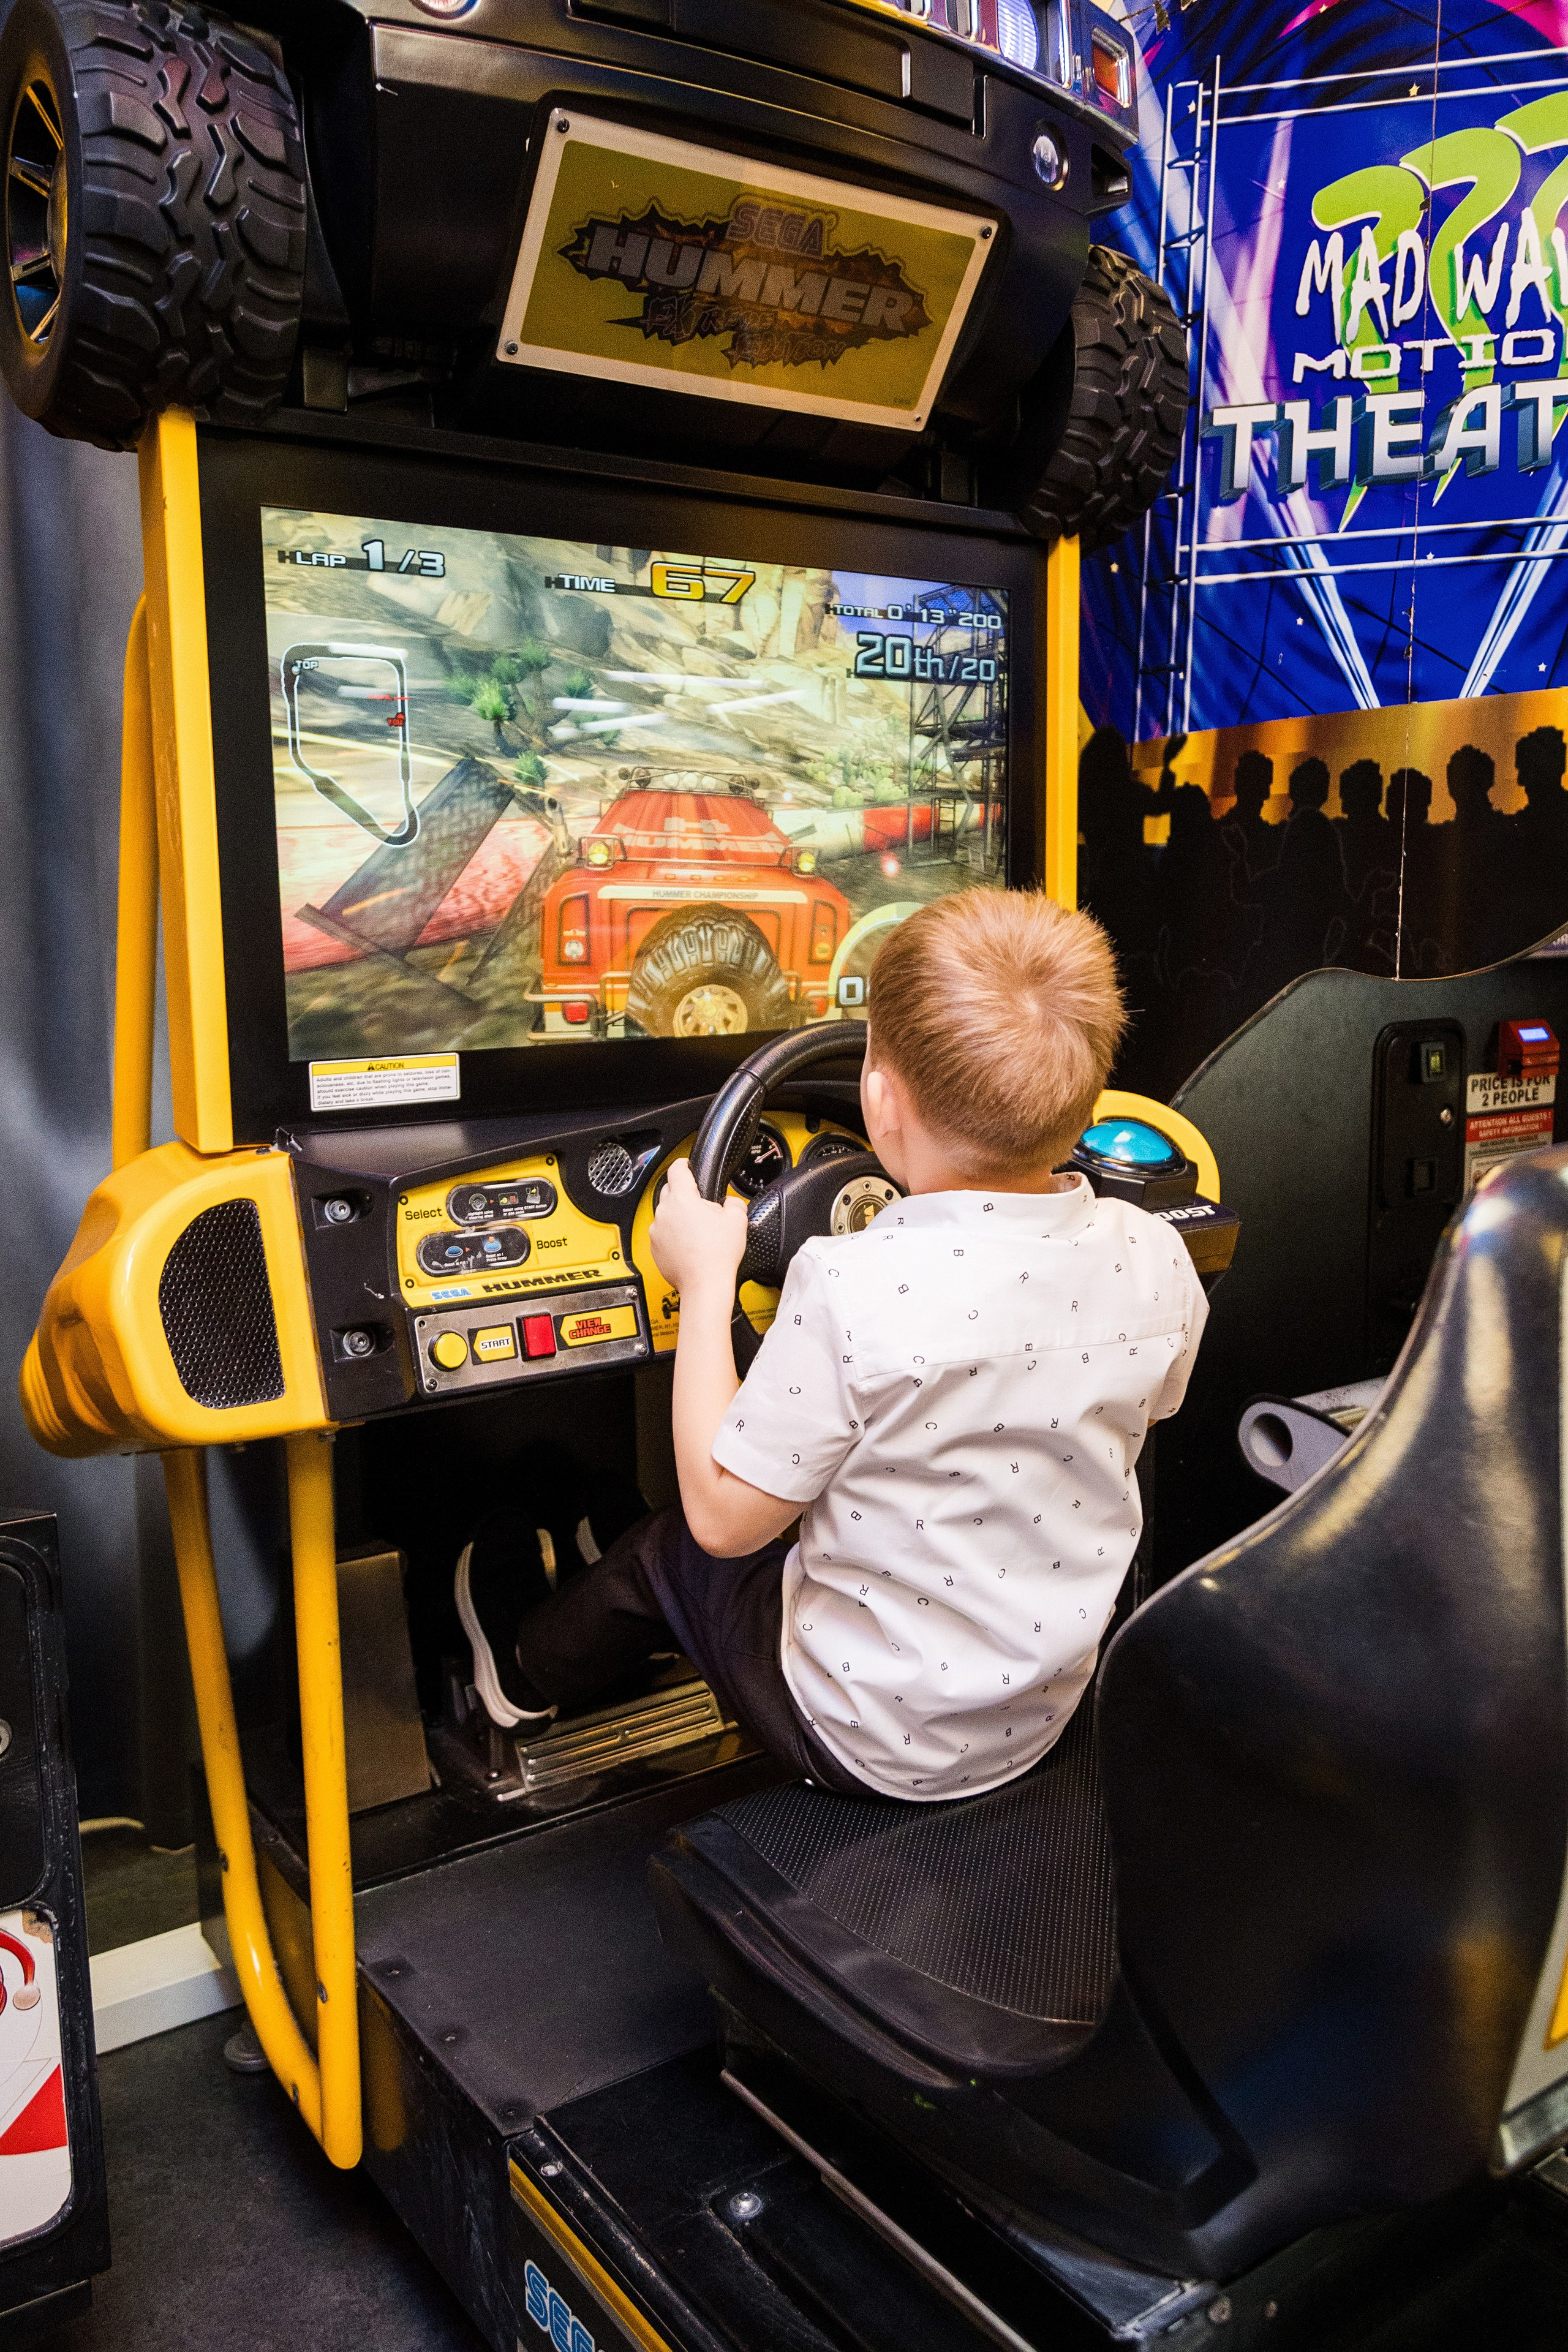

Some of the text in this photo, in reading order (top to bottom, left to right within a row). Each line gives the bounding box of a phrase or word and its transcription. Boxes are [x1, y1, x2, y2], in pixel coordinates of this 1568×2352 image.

[727, 201, 824, 260] SEGA
[586, 224, 914, 333] HUMMER
[1295, 225, 1427, 345] MAD
[1292, 328, 1568, 383] MOTIO
[295, 551, 347, 567] LAP
[558, 560, 756, 604] TIME 67
[833, 604, 883, 619] TOTAL
[295, 659, 319, 669] TOP
[652, 889, 759, 900] HUMMER CHAMPIONSHIP
[1471, 1076, 1508, 1093] PRICE
[1512, 1077, 1523, 1088] IS
[1482, 1087, 1539, 1107] 2 PEOPLE
[405, 1207, 443, 1221] Select
[537, 1237, 568, 1250] Boost
[481, 1268, 604, 1294] HUMMER
[431, 1286, 473, 1301] SEGA
[576, 1316, 601, 1329] VIEW
[568, 1323, 611, 1340] CHANGE
[481, 1337, 511, 1350] START
[524, 2259, 605, 2352] SEG
